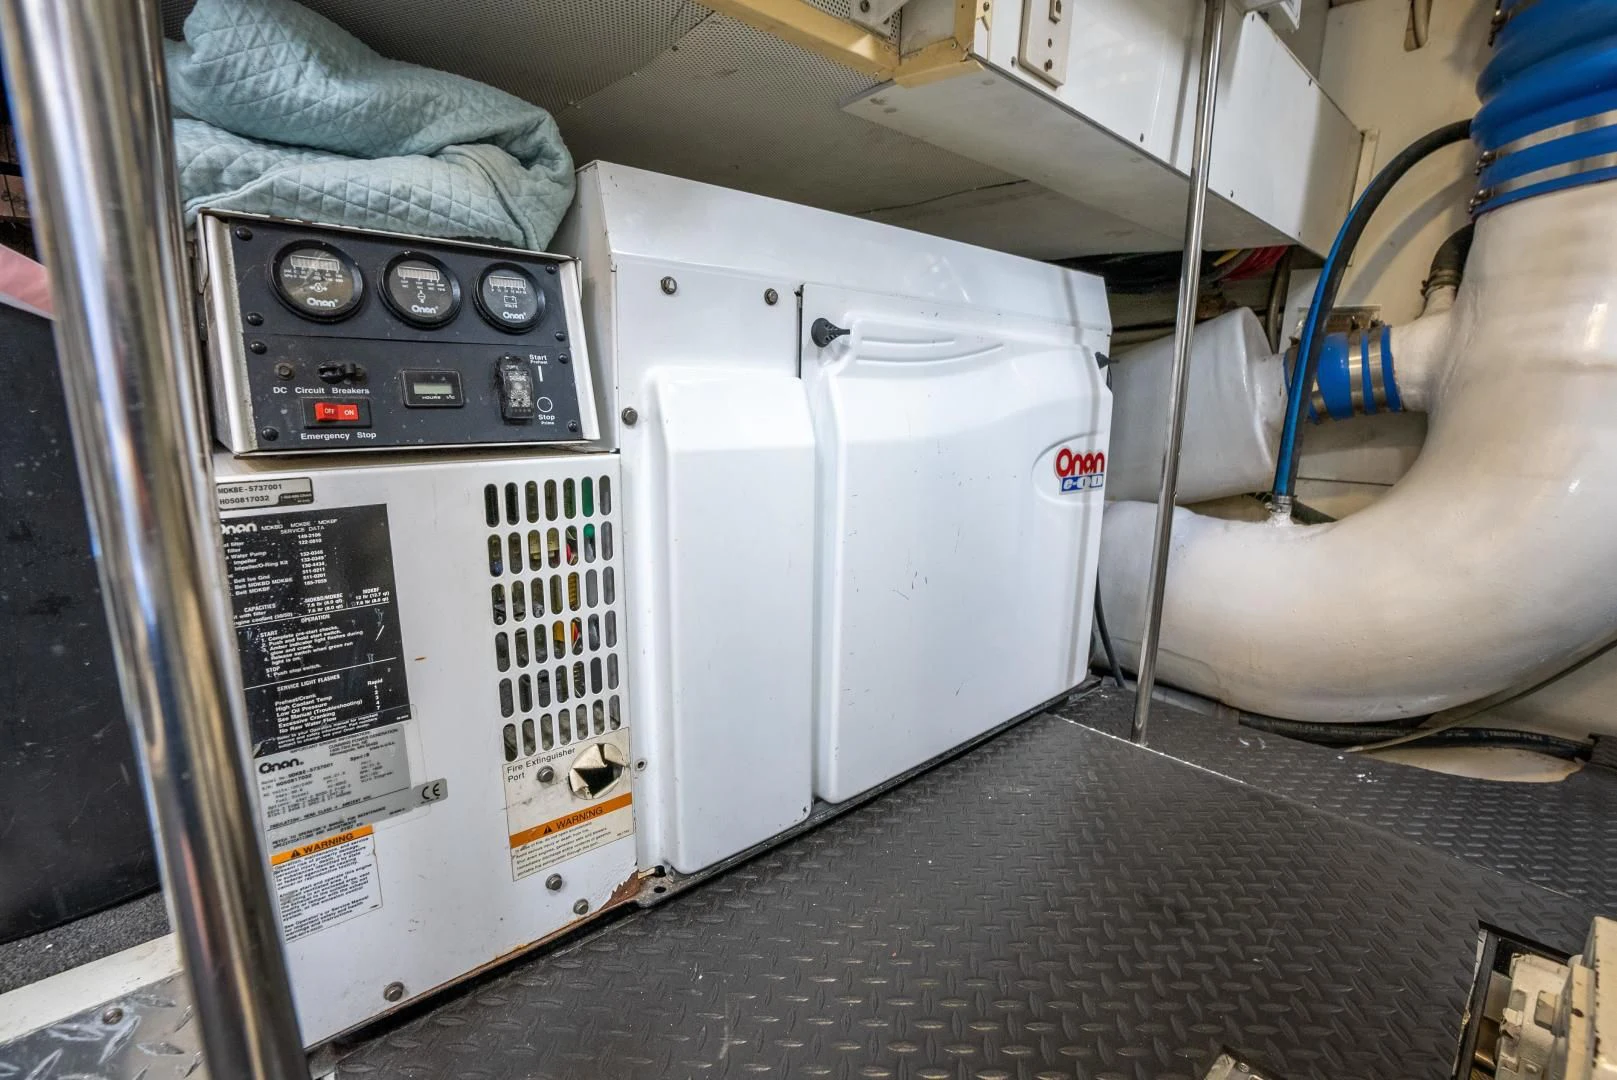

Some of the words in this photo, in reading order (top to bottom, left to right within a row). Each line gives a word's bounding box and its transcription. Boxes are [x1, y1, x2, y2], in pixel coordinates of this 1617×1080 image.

[306, 297, 336, 308] Onan
[411, 305, 436, 314] Onan
[503, 311, 525, 320] Onan
[300, 432, 350, 441] Emergency
[356, 431, 377, 439] Stop
[1056, 448, 1105, 477] Onan
[218, 484, 282, 494] MDKBE-5737001
[233, 558, 257, 566] Impeller
[235, 589, 248, 597] Belt
[244, 603, 276, 612] CAPACITIES
[301, 614, 330, 623] OPERATION
[268, 633, 294, 641] Complete
[289, 639, 313, 648] indicator
[327, 633, 346, 641] flashes
[270, 653, 292, 661] Release
[328, 643, 343, 651] green
[273, 670, 288, 678] Push
[289, 667, 302, 675] stop
[276, 682, 300, 691] SERVICE
[318, 674, 340, 683] FLASHES
[367, 678, 383, 686] Rapid
[274, 693, 317, 706] Preheat/Crank
[275, 704, 290, 712] High
[291, 699, 315, 708] Coolant
[316, 695, 333, 703] Temp
[276, 710, 290, 718] Low
[301, 702, 328, 711] Pressure
[278, 715, 290, 724] See
[290, 711, 312, 720] Manual
[313, 699, 363, 715] (Troubleshooting)
[278, 717, 308, 729] Excessive
[309, 711, 336, 721] Cranking
[290, 724, 303, 732] Raw
[304, 720, 322, 728] Water
[322, 716, 337, 724] Flow
[259, 757, 300, 774] Onan
[507, 763, 523, 774] Fire
[526, 748, 576, 768] Extinguisher
[508, 772, 525, 783] Port
[556, 806, 603, 830] WARNING
[303, 833, 354, 854] WARNING
